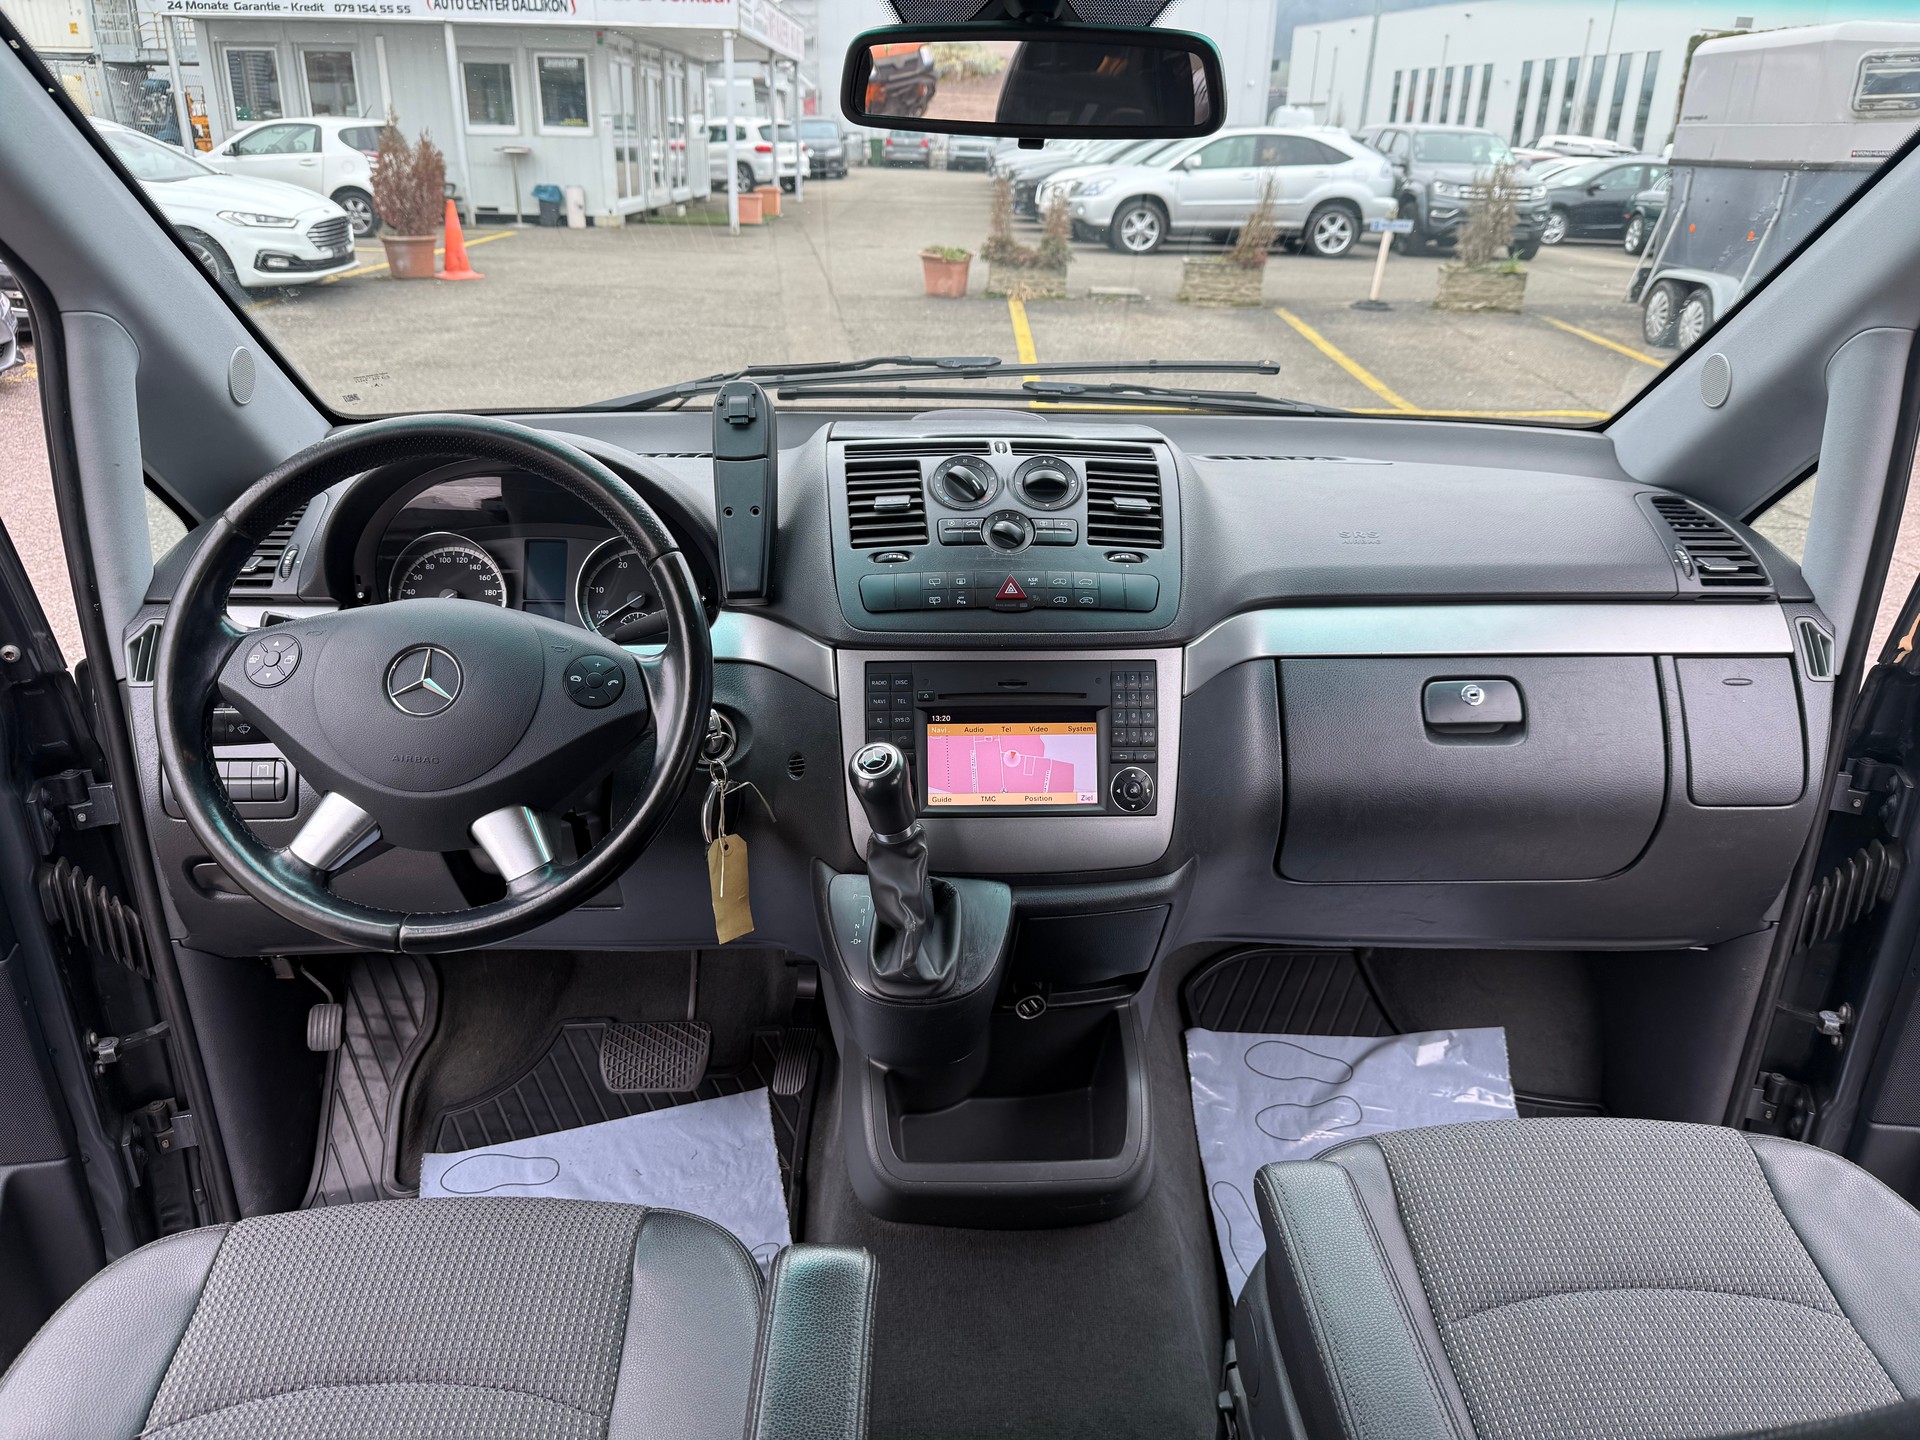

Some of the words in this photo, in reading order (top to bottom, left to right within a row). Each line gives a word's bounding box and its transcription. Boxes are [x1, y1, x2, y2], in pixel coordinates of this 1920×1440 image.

[167, 1, 182, 10] 24
[185, 1, 229, 10] Monate
[233, 2, 281, 11] Garantie
[291, 2, 325, 12] Kredit
[334, 3, 355, 13] 079
[357, 4, 377, 13] 154
[380, 5, 394, 14] 55
[396, 5, 411, 14] 55
[434, 0, 464, 10] AUTO
[467, 0, 509, 11] CENTER
[392, 754, 440, 764] AIRBAG
